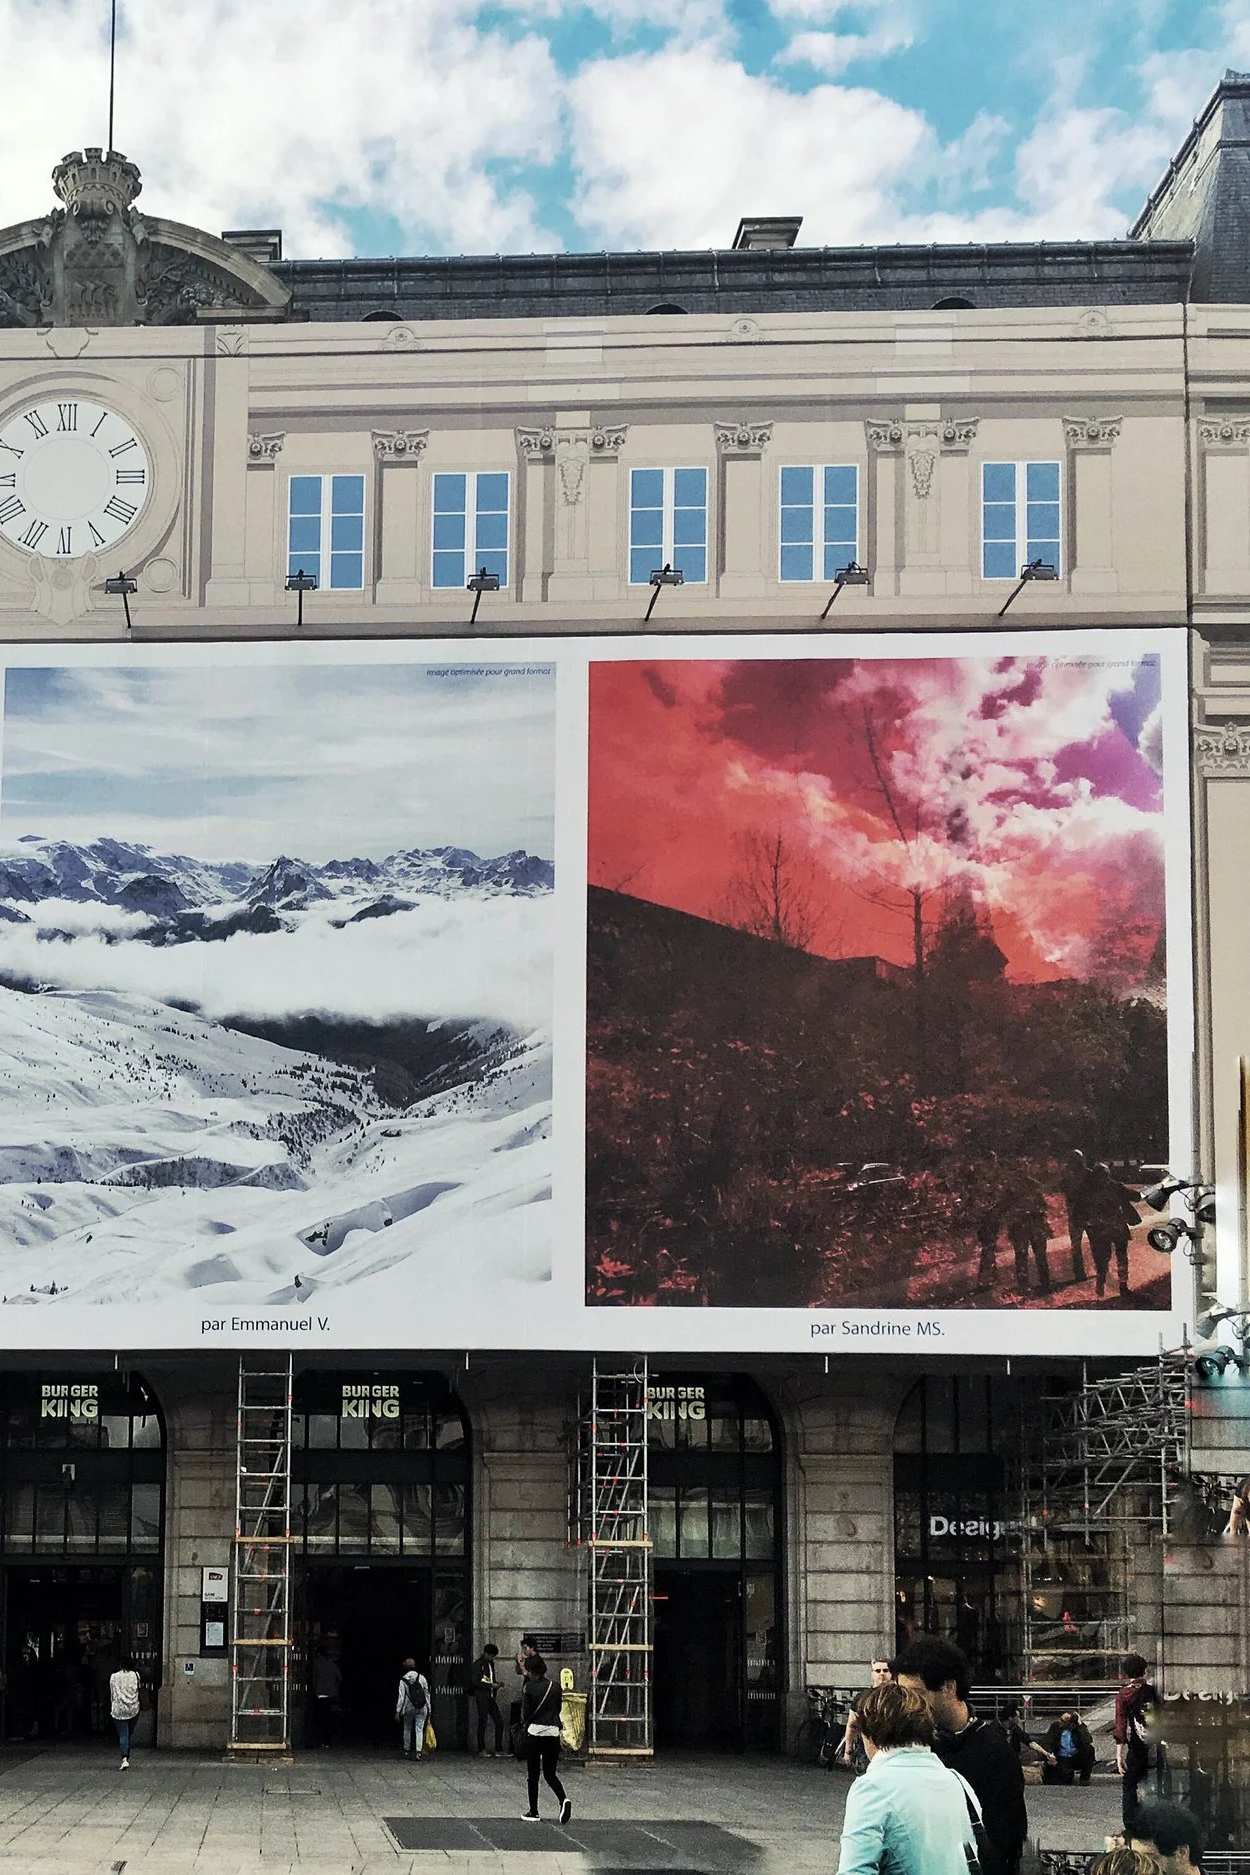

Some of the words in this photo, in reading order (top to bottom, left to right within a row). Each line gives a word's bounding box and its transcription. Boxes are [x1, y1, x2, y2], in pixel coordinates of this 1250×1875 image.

[23, 410, 49, 439] XI
[57, 404, 78, 431] XII
[90, 412, 108, 437] I
[108, 438, 137, 458] II
[116, 469, 145, 485] III
[103, 495, 138, 525] IIII
[87, 520, 106, 547] V
[427, 668, 449, 677] Image
[485, 668, 503, 676] pour
[504, 668, 525, 677] grand
[526, 667, 551, 675] format
[201, 1320, 226, 1334] par
[231, 1316, 312, 1331] Emmanuel
[317, 1317, 330, 1331] V.
[810, 1323, 836, 1338] par
[841, 1320, 911, 1336] Sandrine
[916, 1321, 945, 1336] MS.
[41, 1384, 98, 1397] BURGER
[342, 1385, 400, 1398] BURGER
[647, 1386, 705, 1399] BURGER
[41, 1398, 99, 1418] KING
[341, 1399, 400, 1418] KING
[647, 1401, 706, 1420] KING
